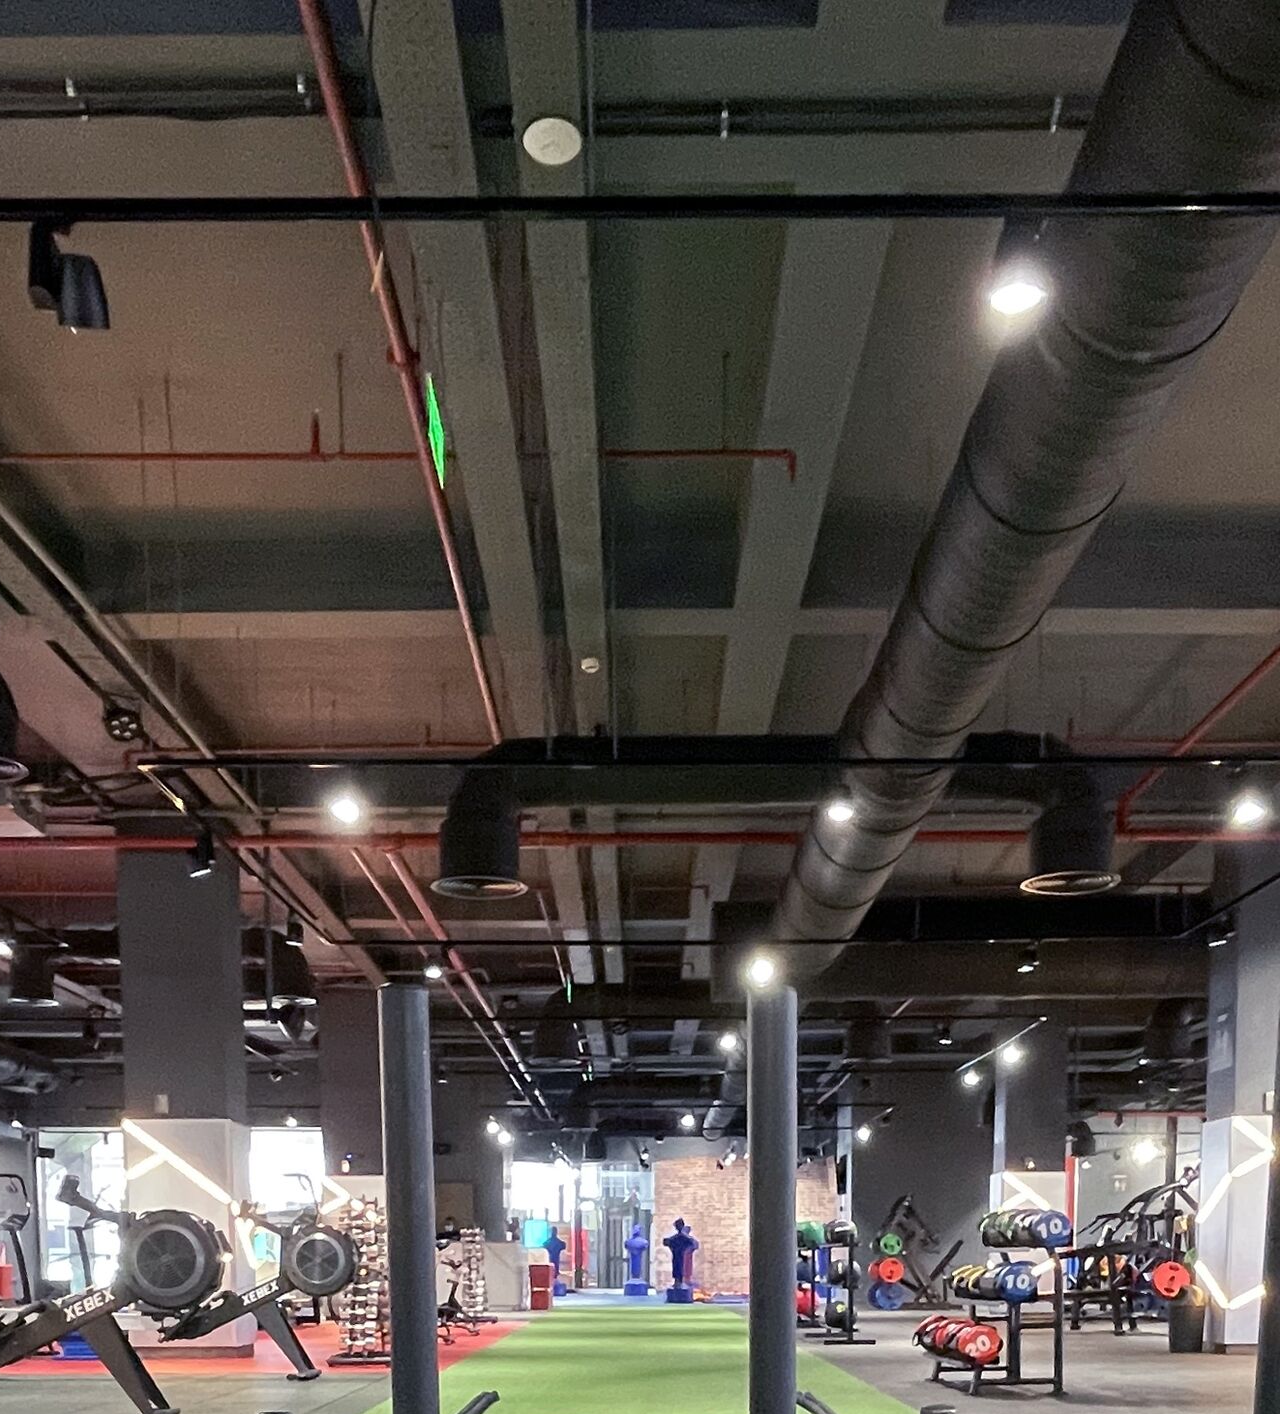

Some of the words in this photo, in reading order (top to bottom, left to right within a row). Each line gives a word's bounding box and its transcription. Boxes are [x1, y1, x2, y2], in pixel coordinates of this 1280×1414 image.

[1037, 1217, 1063, 1239] 10
[241, 1279, 280, 1306] XEBEX
[1005, 1277, 1030, 1290] 10
[63, 1286, 116, 1322] XEBEX
[965, 1334, 991, 1357] 20
